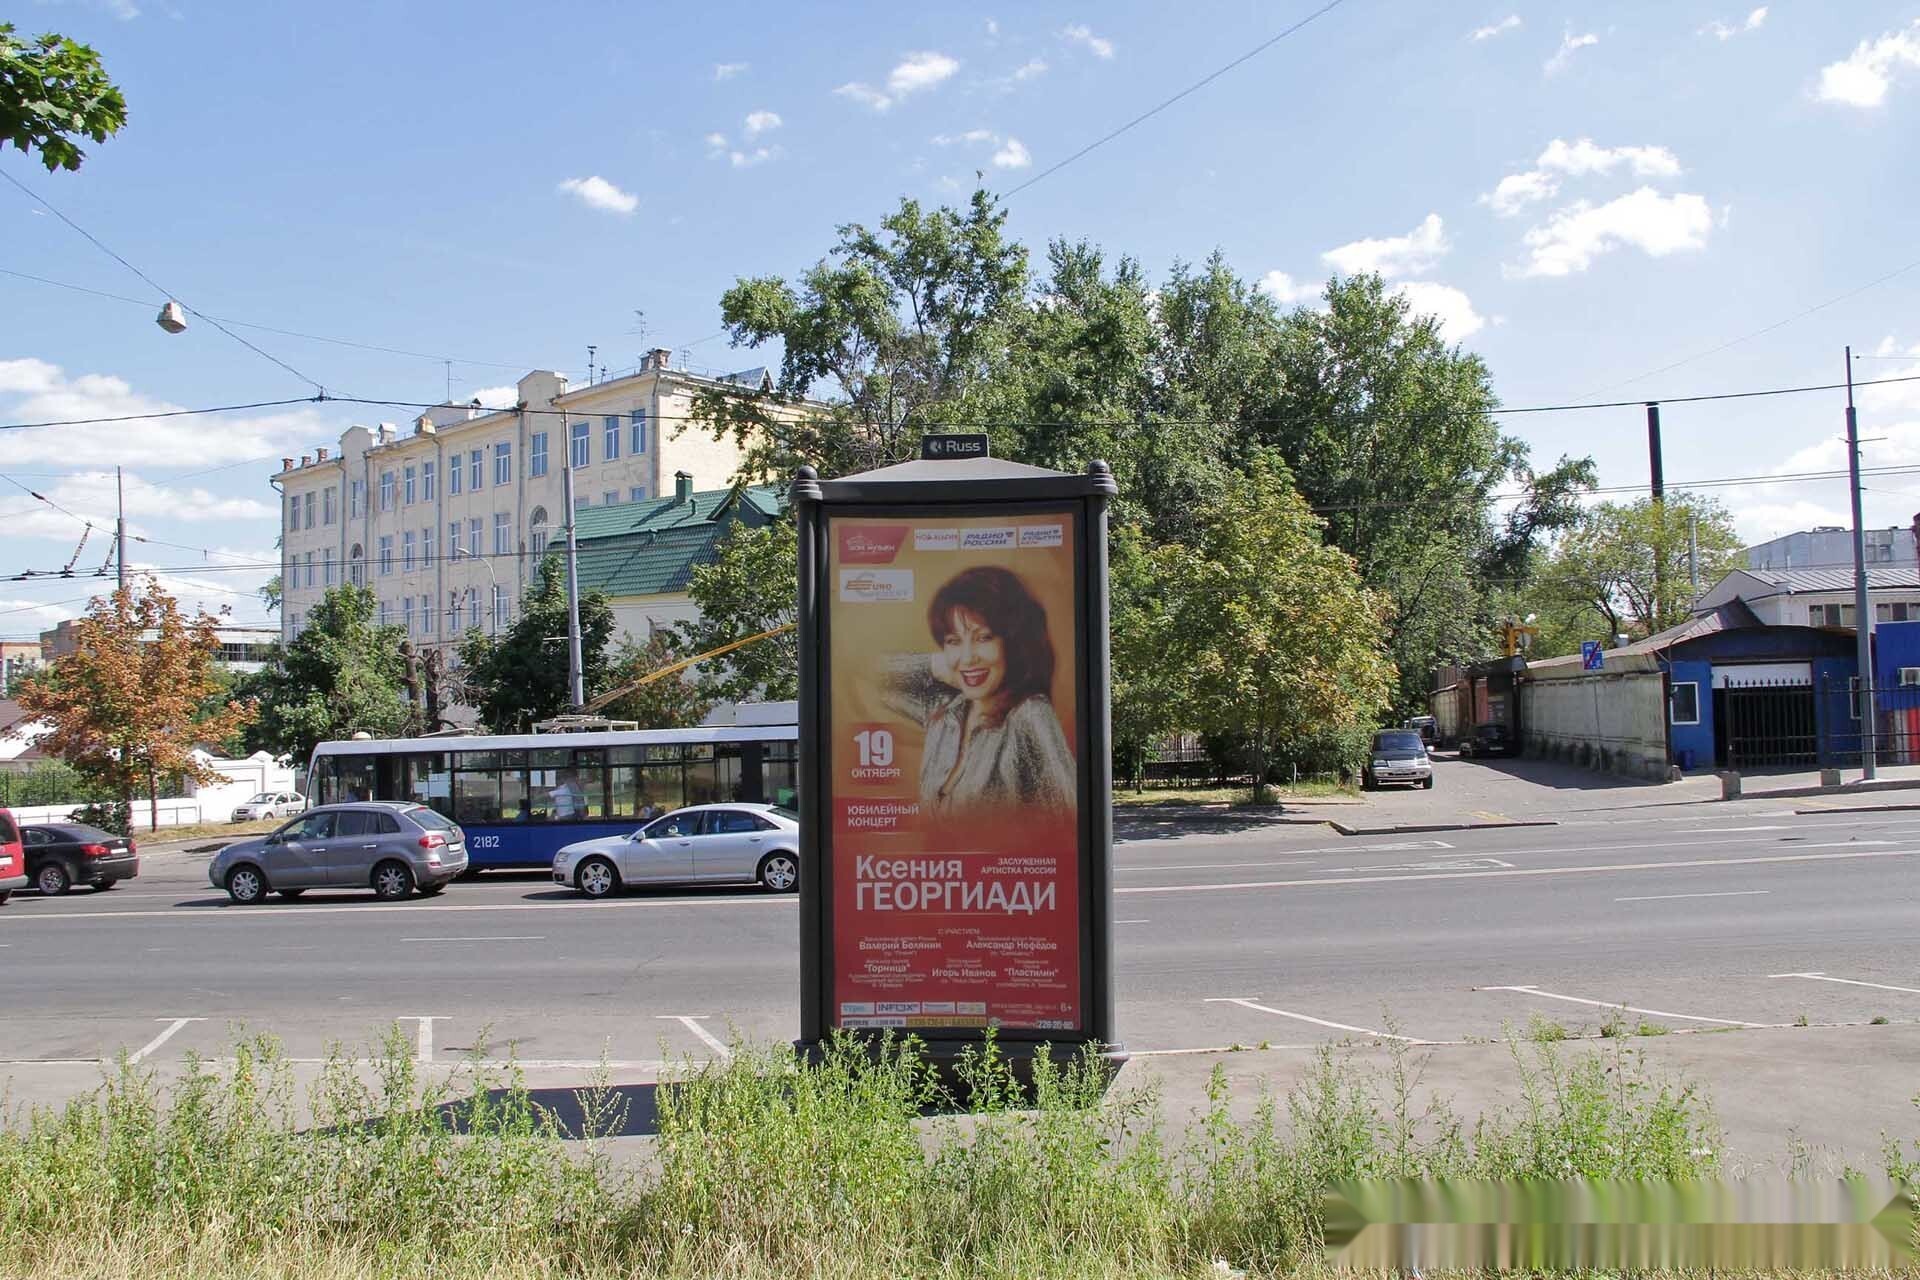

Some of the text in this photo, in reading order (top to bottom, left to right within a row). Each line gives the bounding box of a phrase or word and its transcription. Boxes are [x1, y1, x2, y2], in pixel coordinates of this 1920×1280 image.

[946, 440, 981, 452] Russ
[854, 730, 893, 766] 19
[851, 768, 901, 778] ОКТЯБРЯ
[847, 803, 920, 815] ЮБИЛЕЙНЫЙ
[847, 816, 897, 828] КОНЦЕРТ
[473, 835, 500, 849] 2182
[856, 855, 963, 879] Ксения
[997, 857, 1056, 866] ЗАСЛУЖЕННАЯ
[981, 866, 1057, 875] АРТИСТКА РОССИИ
[856, 881, 1056, 915] ГЕОРГИАДИ
[932, 968, 997, 978] Игорь Иванов
